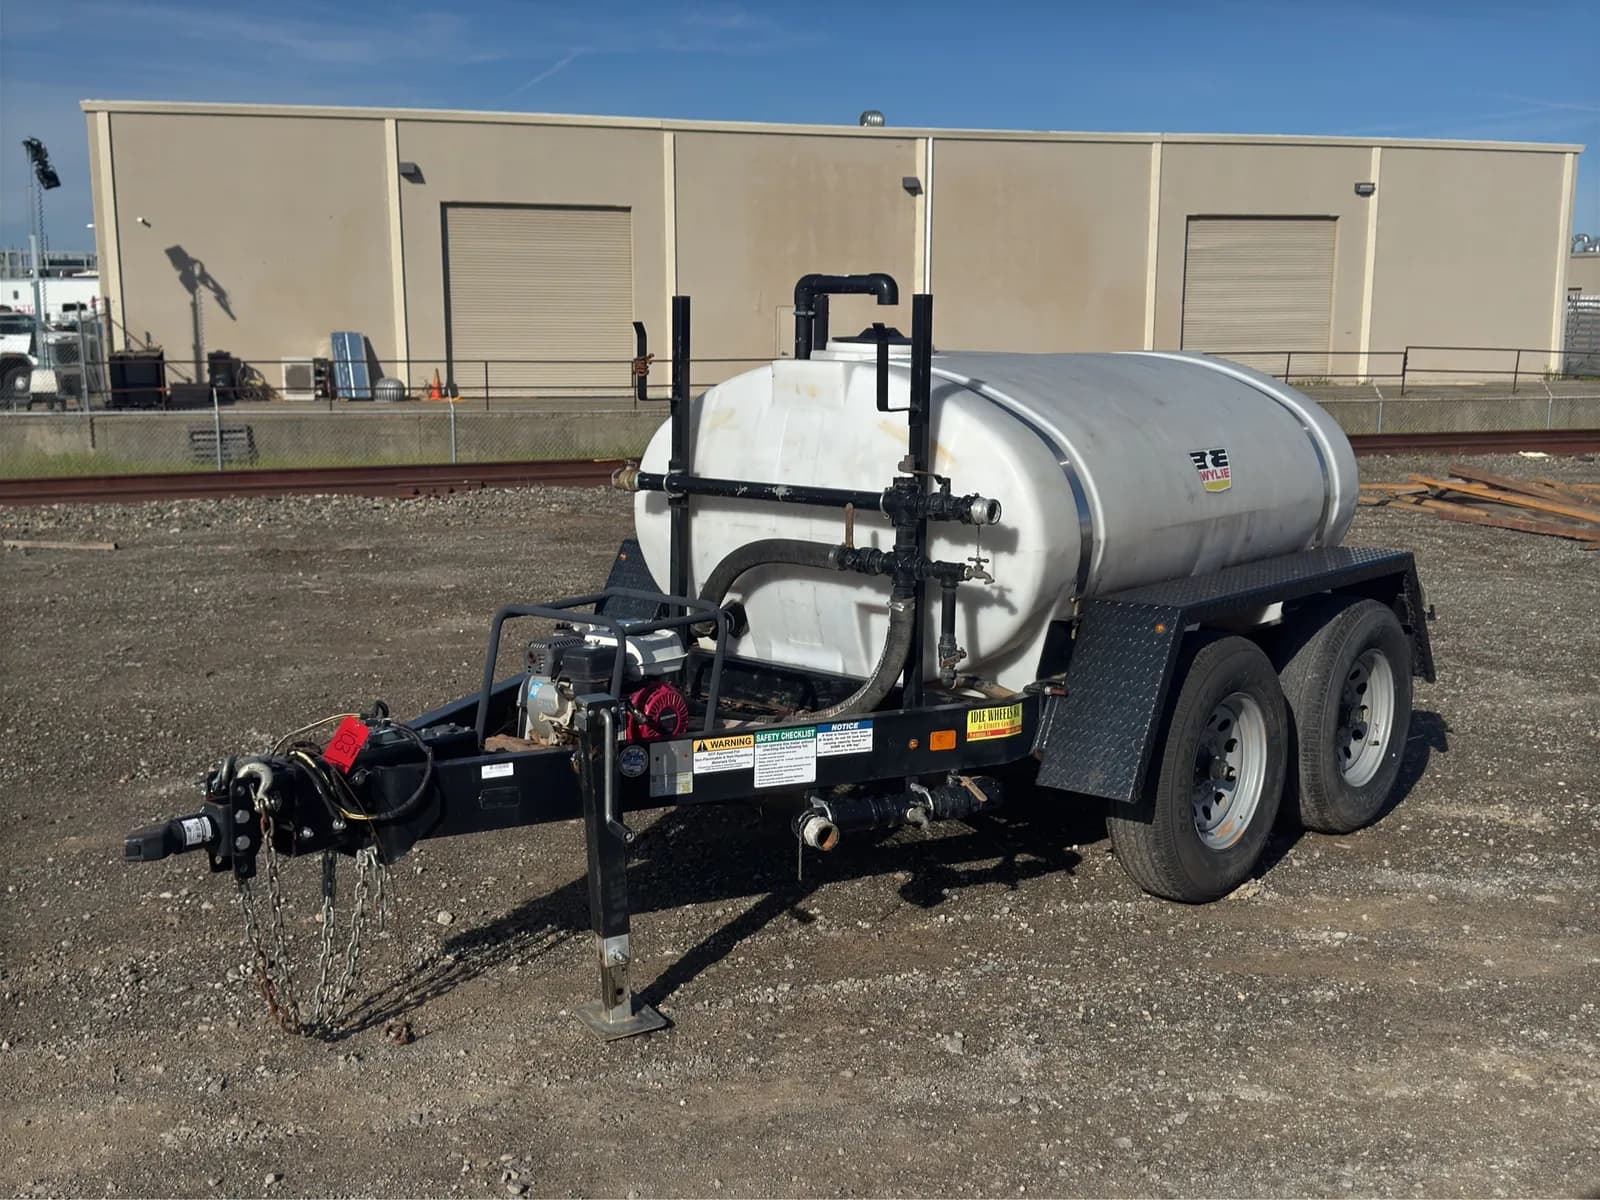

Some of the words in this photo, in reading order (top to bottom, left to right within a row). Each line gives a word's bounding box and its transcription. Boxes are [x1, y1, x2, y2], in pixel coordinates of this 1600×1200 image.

[1200, 467, 1229, 481] WYLIE
[971, 710, 985, 723] IDLE
[988, 707, 1012, 721] WHEELS
[831, 722, 859, 731] NOTICE
[756, 733, 780, 742] SAFETY
[781, 729, 815, 740] CHECKLIST
[710, 737, 752, 748] WARNING
